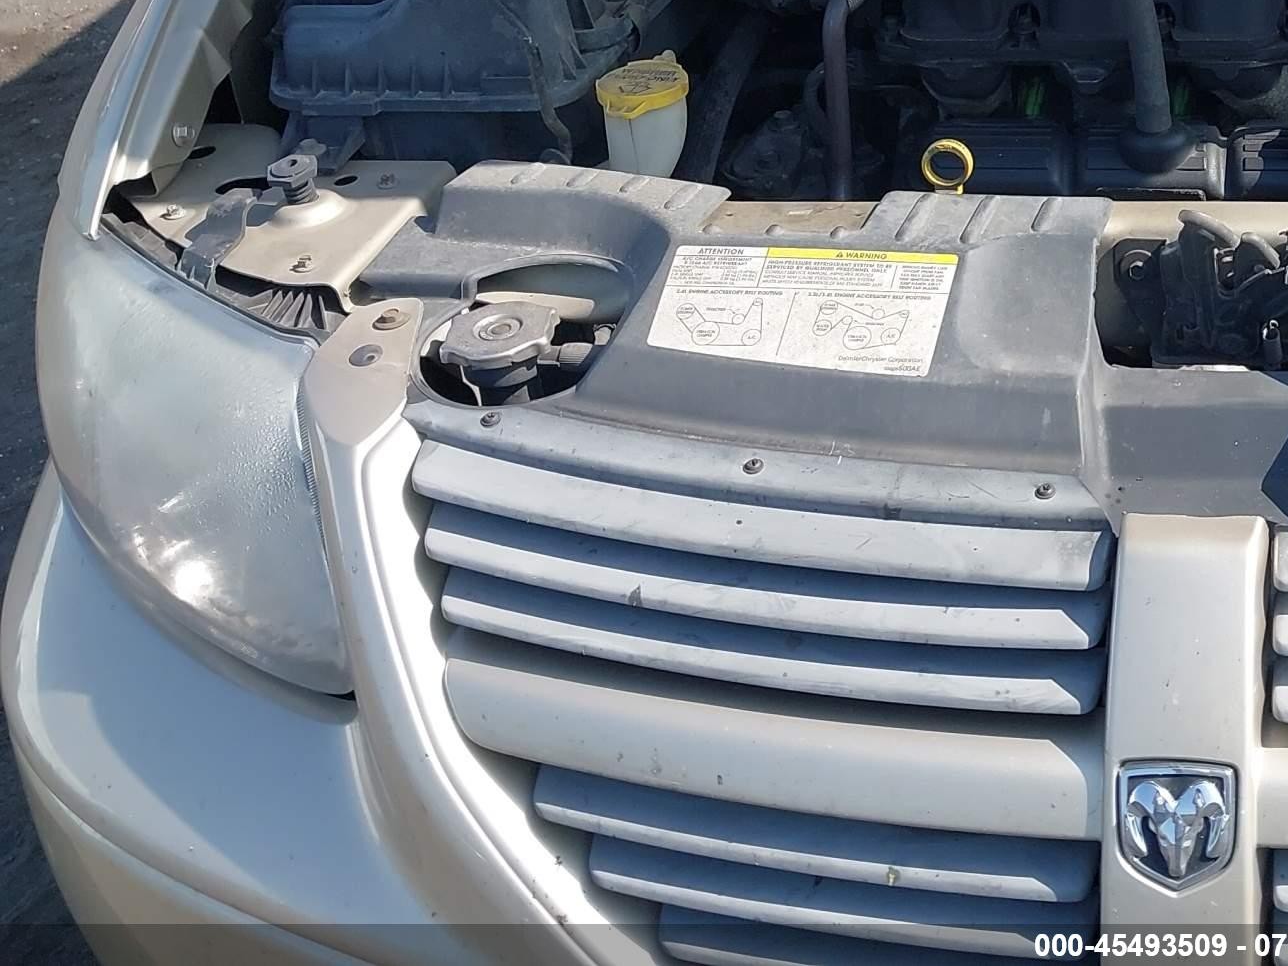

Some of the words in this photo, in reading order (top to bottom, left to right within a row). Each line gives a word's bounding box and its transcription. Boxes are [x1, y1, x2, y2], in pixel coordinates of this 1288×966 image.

[697, 247, 745, 255] ATTENTION
[845, 252, 887, 260] WARNING
[838, 355, 887, 363] DaimlerChrysler
